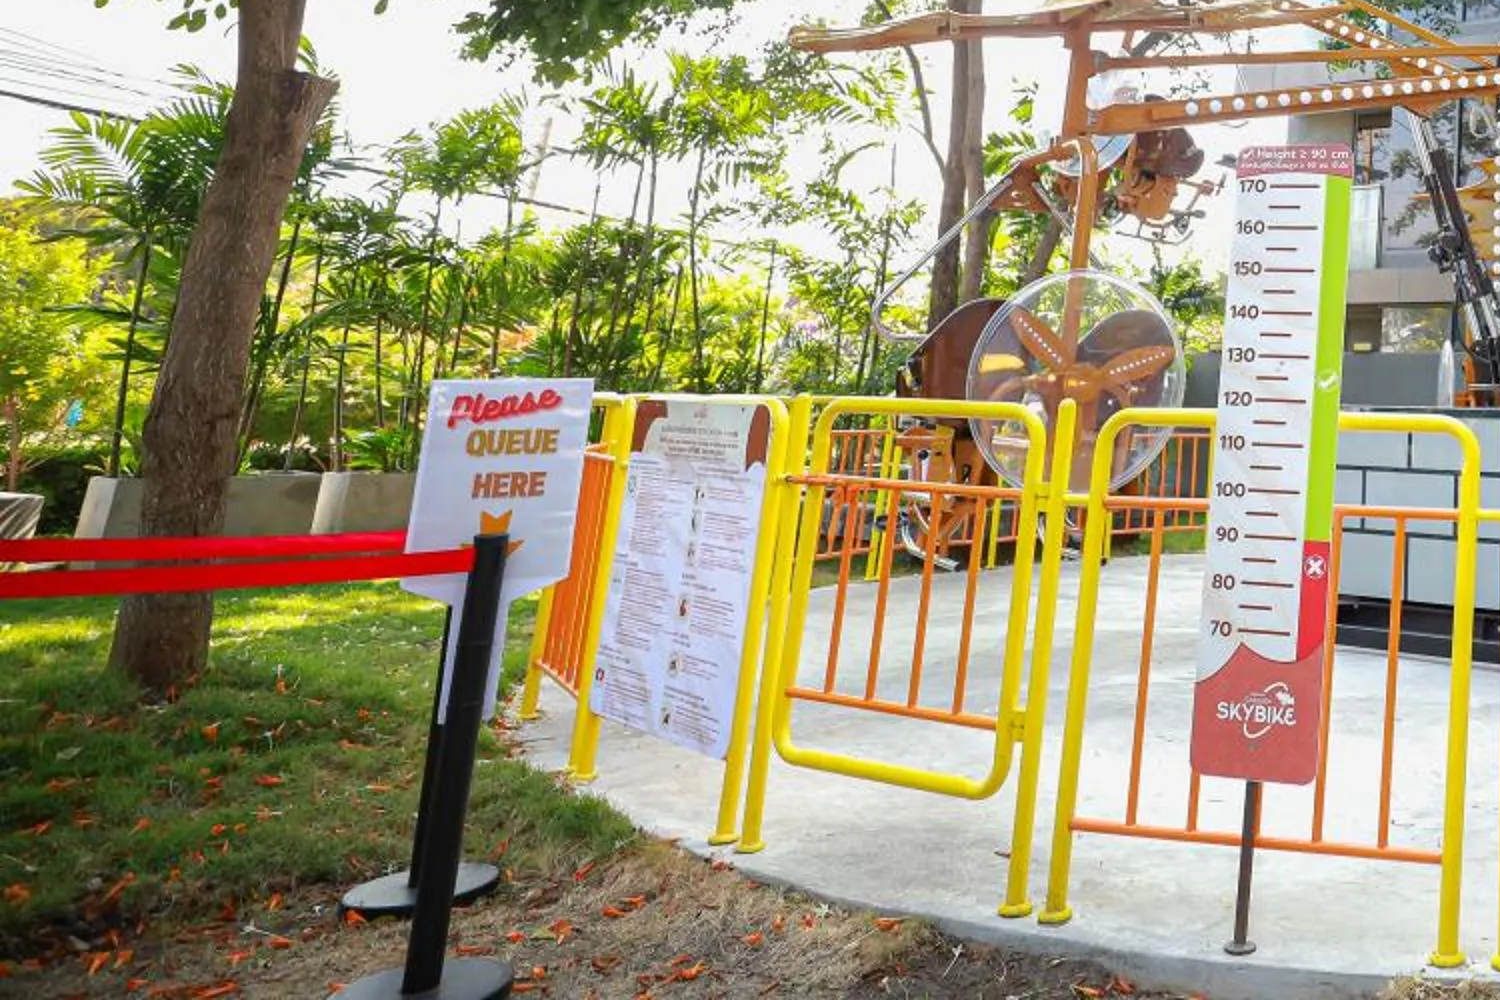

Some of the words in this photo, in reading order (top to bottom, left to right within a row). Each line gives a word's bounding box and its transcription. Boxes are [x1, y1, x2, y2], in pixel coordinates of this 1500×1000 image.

[1257, 148, 1297, 161] Height
[1311, 148, 1327, 159] 90
[1331, 149, 1349, 159] cm
[1239, 179, 1267, 193] 170
[1236, 220, 1265, 235] 160
[1233, 261, 1262, 276] 150
[1230, 304, 1259, 319] 140
[1227, 347, 1256, 363] 130
[1223, 391, 1253, 407] 120
[447, 389, 562, 428] Please
[465, 428, 560, 457] QUEUE
[1219, 435, 1245, 451] 110
[471, 471, 547, 500] HERE
[1216, 481, 1246, 498] 100
[1215, 526, 1239, 543] 90
[1211, 573, 1236, 591] 80
[1210, 620, 1233, 638] 70
[1215, 701, 1297, 727] SKYBIKE
